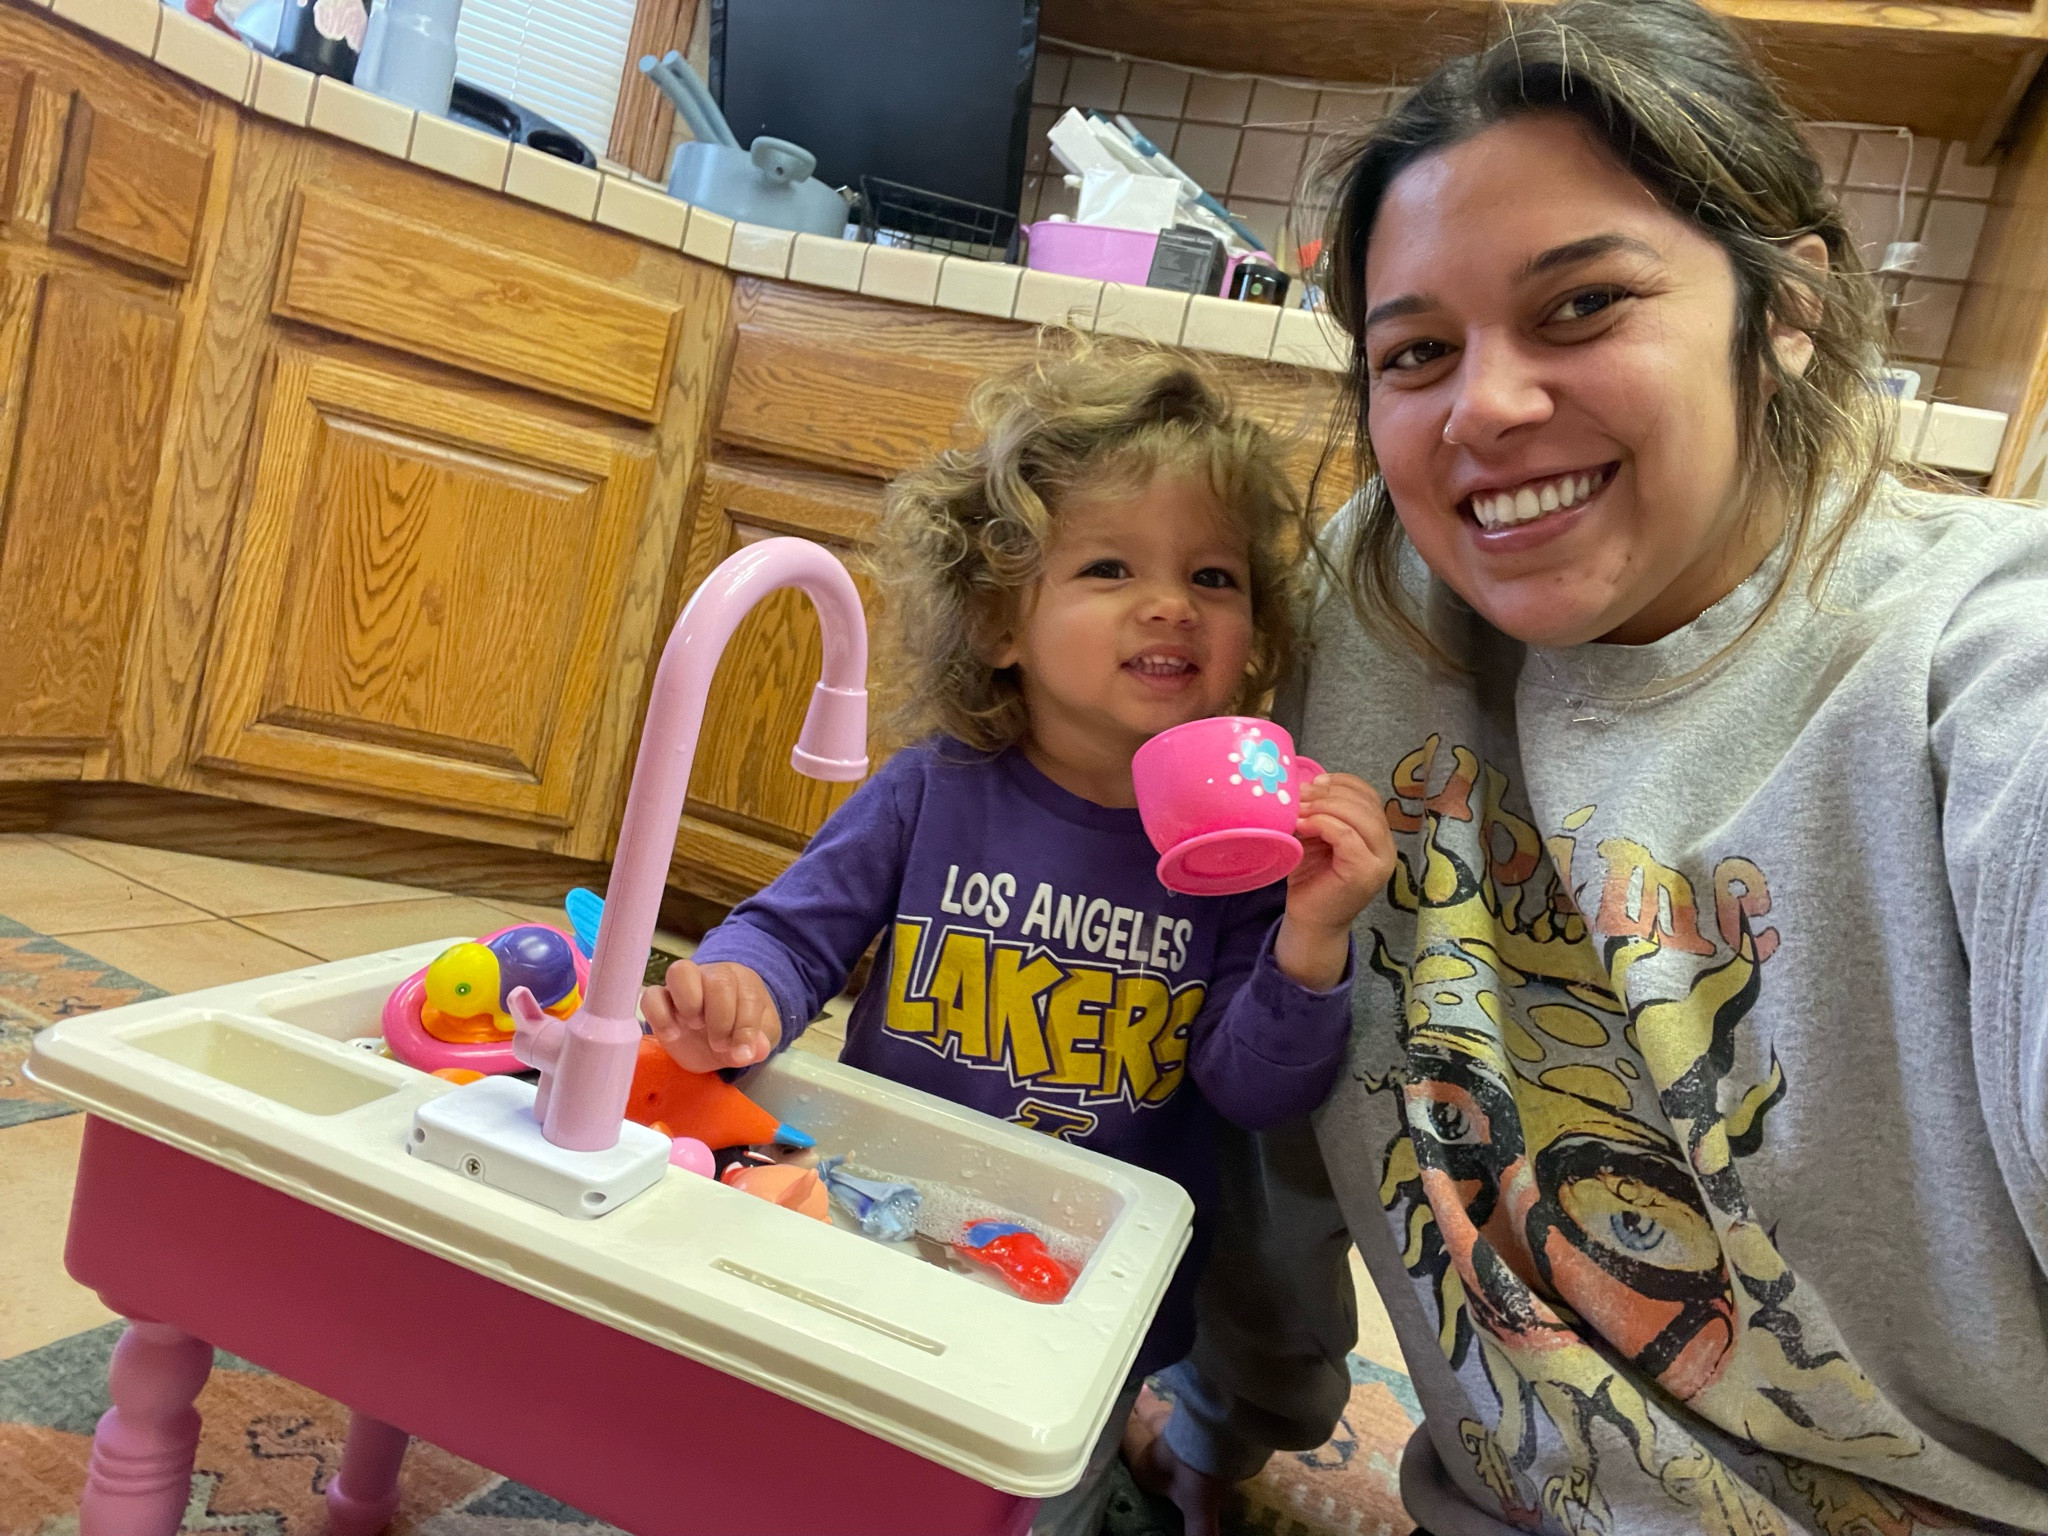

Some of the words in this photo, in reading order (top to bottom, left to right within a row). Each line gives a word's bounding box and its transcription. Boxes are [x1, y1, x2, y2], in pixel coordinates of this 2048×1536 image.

[941, 865, 1016, 928] LOS
[1020, 882, 1192, 972] ANGELES
[884, 916, 1207, 1111] LAKERS
